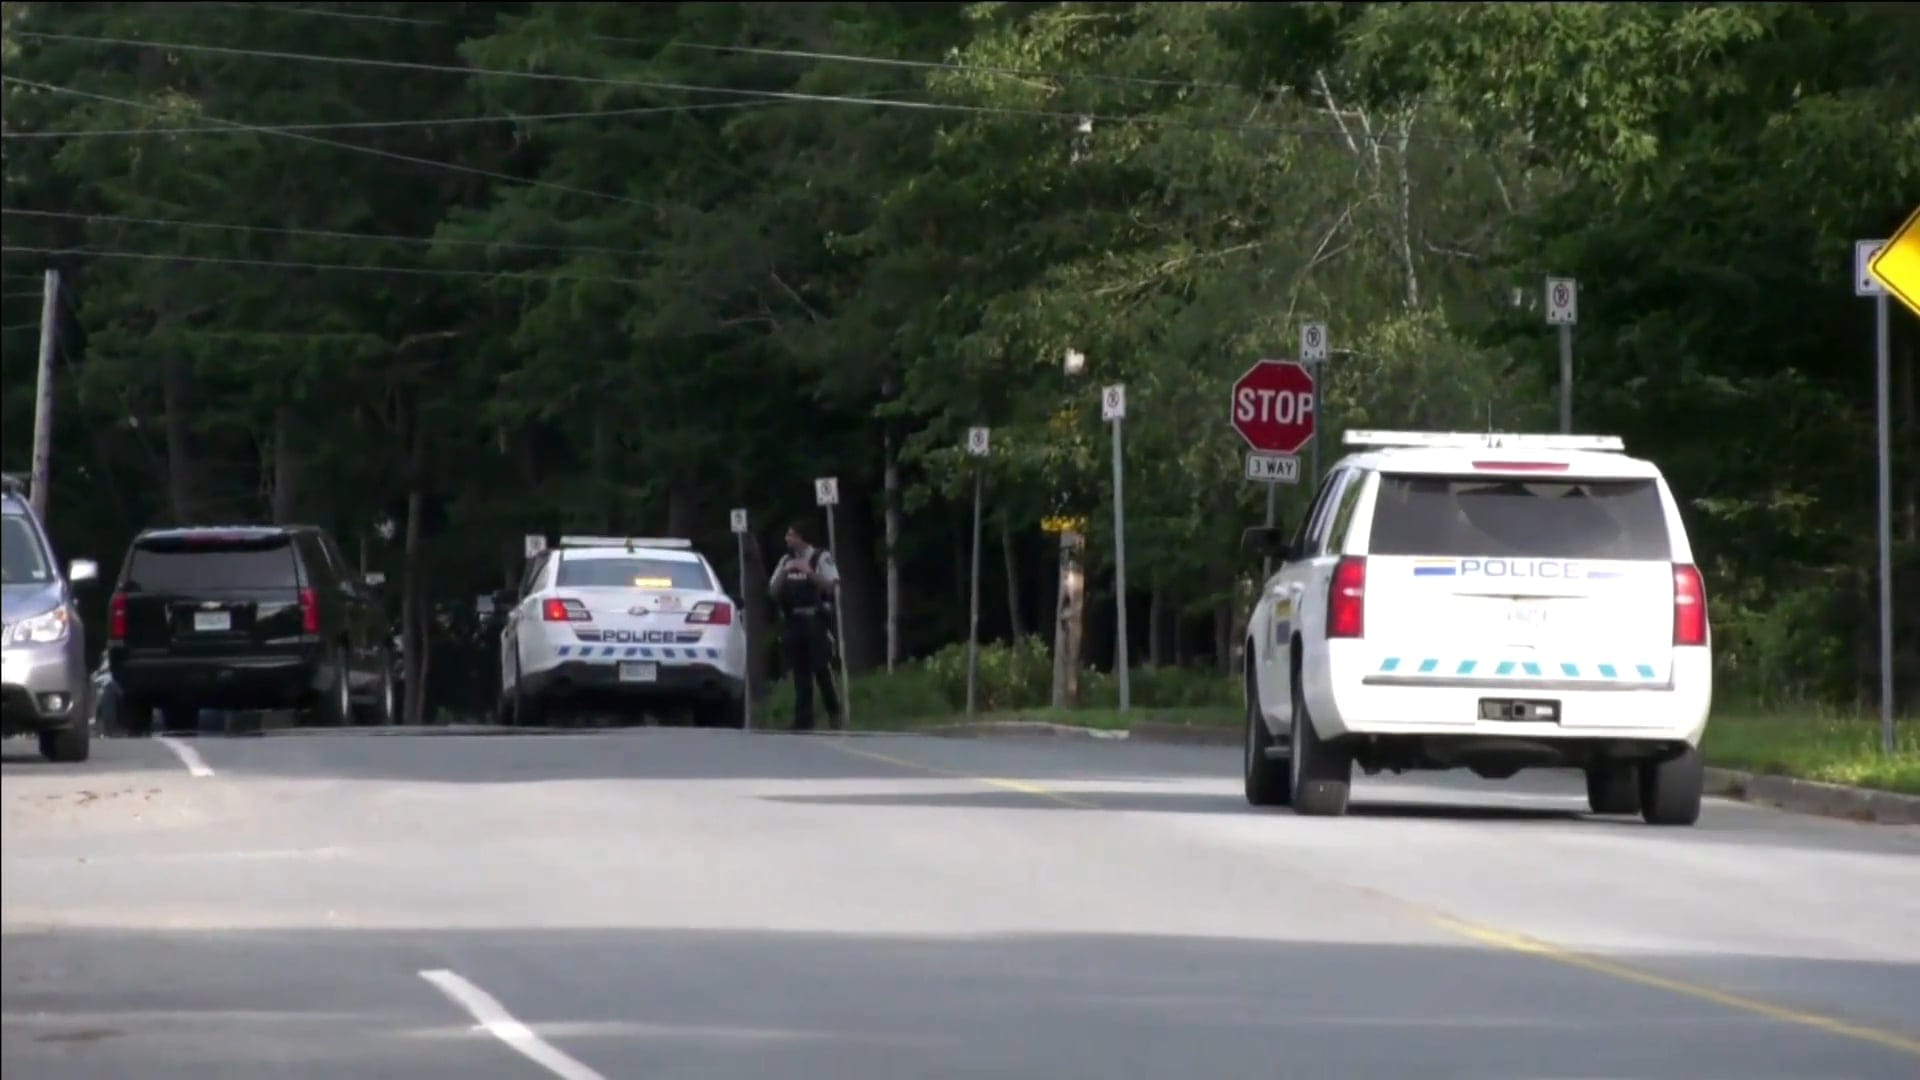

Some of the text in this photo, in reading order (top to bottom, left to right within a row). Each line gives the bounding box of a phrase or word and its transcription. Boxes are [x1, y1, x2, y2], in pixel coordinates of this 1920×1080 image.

[1237, 387, 1314, 426] STOP
[1254, 459, 1293, 476] 3 WAY
[1461, 559, 1580, 579] POLICE
[602, 630, 675, 644] POLICE
